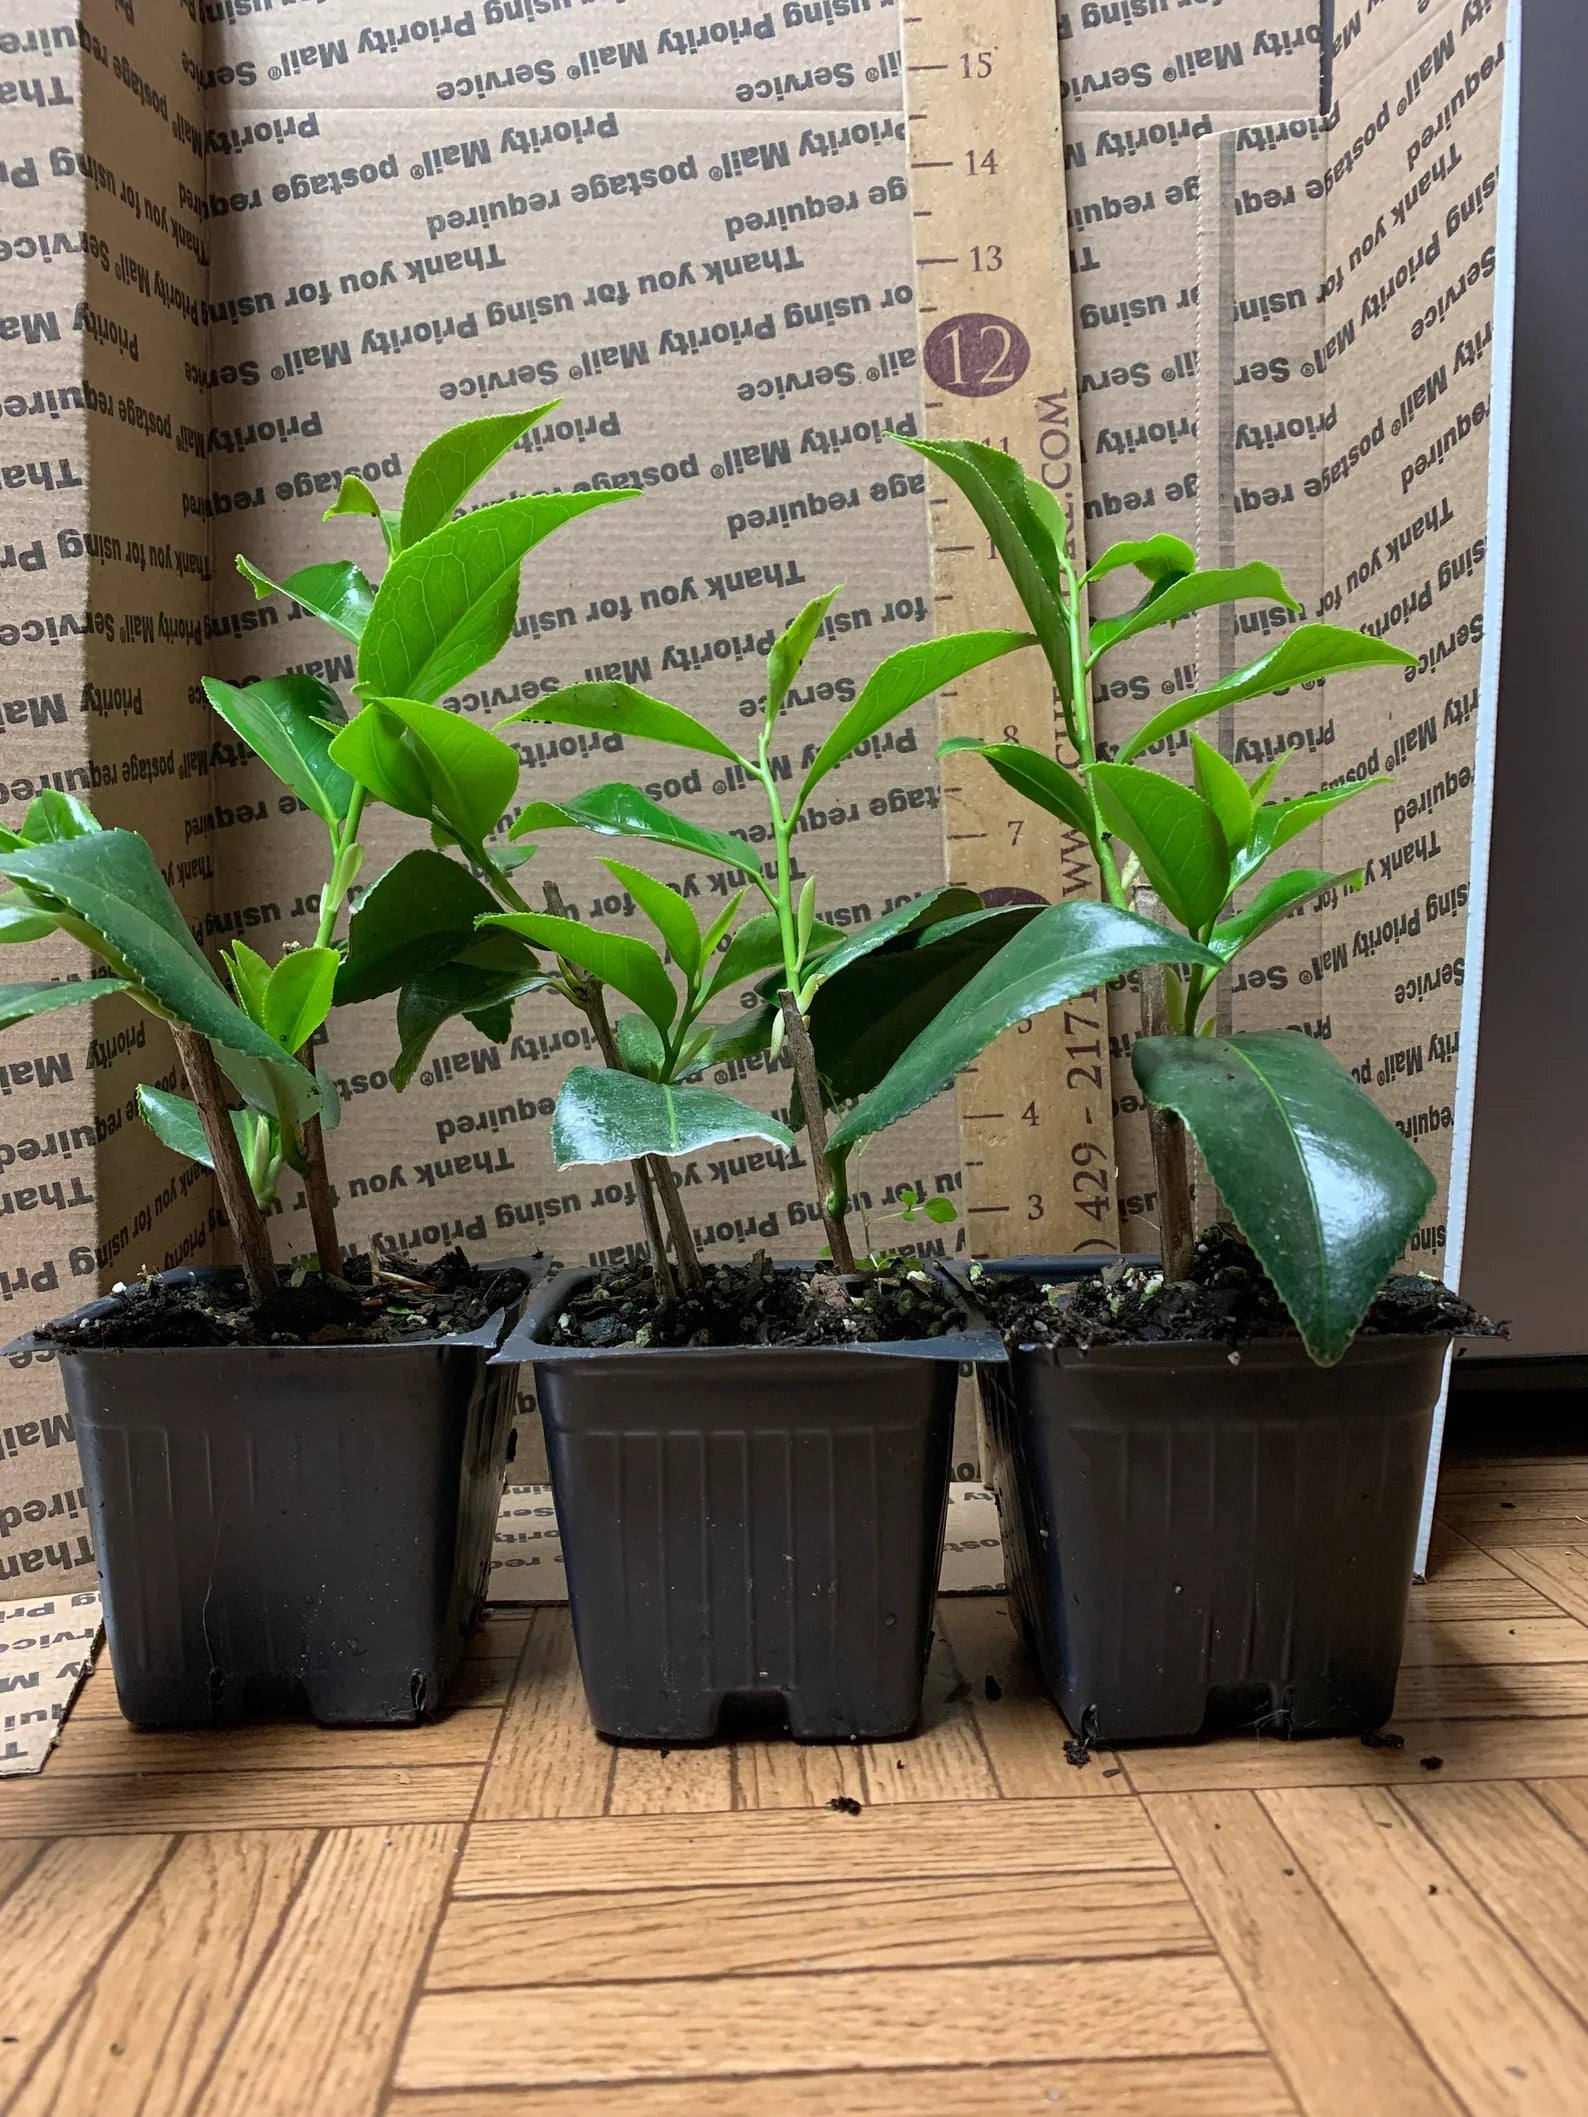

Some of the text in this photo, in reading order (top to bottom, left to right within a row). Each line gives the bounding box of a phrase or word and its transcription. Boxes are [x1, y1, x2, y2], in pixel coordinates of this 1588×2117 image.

[358, 10, 476, 54] Priority
[657, 12, 776, 55] Priority
[783, 0, 871, 28] using
[735, 0, 1168, 102] using Service
[1252, 24, 1321, 57] ority
[436, 59, 556, 101] Service
[960, 52, 993, 79] 15
[112, 56, 168, 121] postage
[1407, 41, 1506, 173] required
[204, 111, 320, 156] Priority
[500, 111, 620, 155] Priority
[1095, 113, 1213, 158] Priority
[1236, 100, 1340, 152] Priority
[964, 148, 999, 176] 14
[1305, 100, 1390, 201] postage
[272, 153, 399, 203] postage
[570, 153, 697, 204] postage
[1391, 142, 1462, 228] Thank
[120, 181, 141, 220] for
[144, 197, 168, 234] you
[426, 189, 561, 240] required
[725, 190, 859, 242] required
[403, 243, 506, 284] Thank
[969, 245, 1003, 272] 13
[1348, 214, 1388, 272] you
[339, 260, 398, 295] you
[637, 261, 696, 295] you
[702, 245, 805, 285] Thank
[1316, 266, 1344, 304] for
[1361, 230, 1441, 328] Priority
[284, 279, 332, 307] for
[485, 291, 574, 325] using
[583, 279, 630, 307] for
[783, 291, 871, 329] using
[880, 285, 914, 308] or
[1410, 244, 1497, 341] Service
[73, 302, 140, 362] Priority
[361, 312, 479, 354] Priority
[658, 313, 776, 356] Priority
[737, 292, 1166, 401] using ail® Service
[941, 325, 1017, 387] 12
[439, 359, 559, 401] Service
[120, 396, 172, 440] postage
[207, 411, 323, 458] Priority
[513, 411, 621, 454] Priorit
[800, 412, 918, 455] Priority
[1235, 401, 1337, 451] Priority
[1304, 416, 1386, 499] postage
[727, 488, 860, 540] required
[1387, 497, 1455, 564] Thank
[126, 540, 146, 573] for
[149, 542, 173, 571] you
[1346, 545, 1383, 594] you
[511, 560, 806, 641] Thank you for usin
[882, 597, 928, 622] for
[1316, 583, 1343, 617] for
[0, 611, 115, 646] Service
[661, 628, 775, 672] Priority
[1404, 613, 1485, 683] Service
[80, 682, 144, 719] Priority
[1235, 717, 1336, 766] Priority
[122, 747, 175, 787] postage
[1007, 820, 1024, 846] 7
[179, 853, 214, 888] Thank
[1379, 829, 1442, 882] Thank
[588, 888, 635, 918] for
[1352, 913, 1421, 959] Priority
[1394, 956, 1465, 1005] Service
[86, 1020, 146, 1071] Priority
[436, 1096, 557, 1144] equired
[1021, 1100, 1040, 1127] 4
[348, 1146, 516, 1200] Thank you
[708, 1145, 808, 1186] Thank
[152, 1177, 177, 1215] you
[1028, 1193, 1045, 1220] 3
[132, 1206, 153, 1241] for
[372, 1181, 637, 1257] for using Priority
